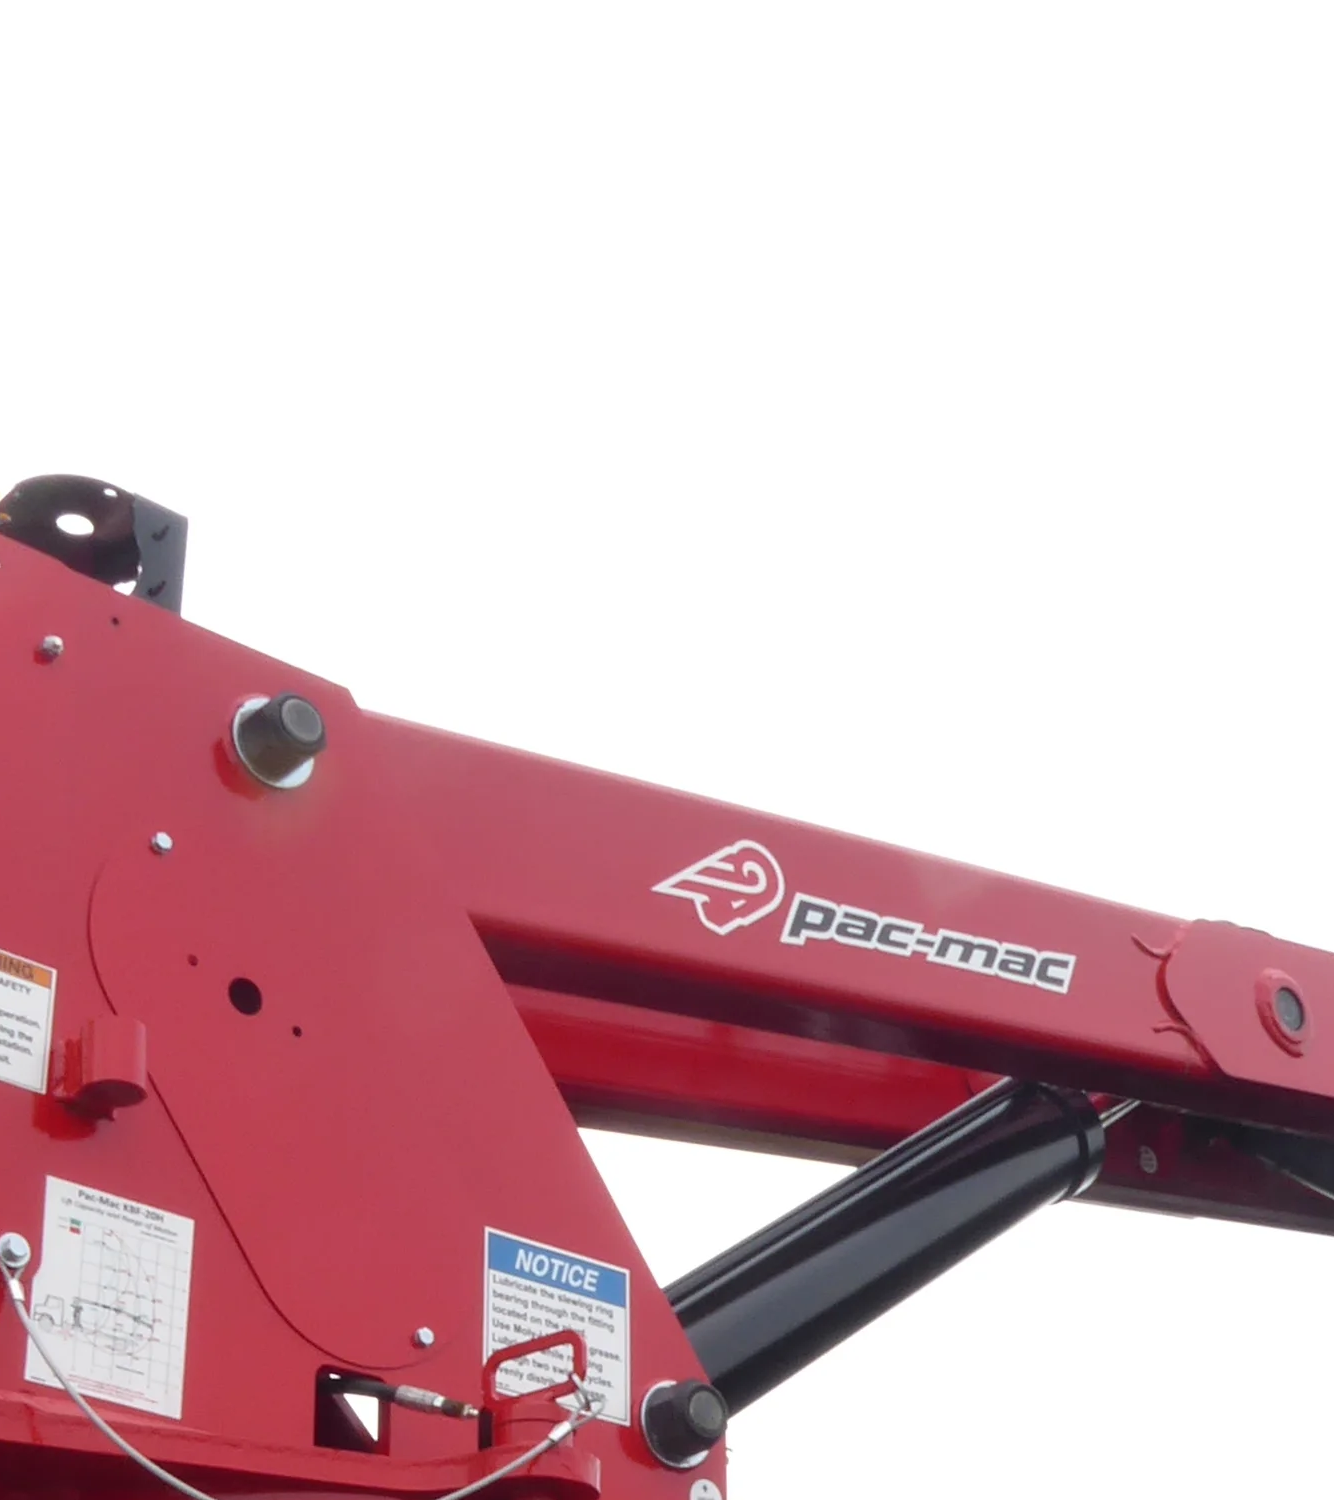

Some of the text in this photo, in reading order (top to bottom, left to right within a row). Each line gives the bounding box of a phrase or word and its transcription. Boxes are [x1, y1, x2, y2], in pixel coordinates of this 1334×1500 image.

[784, 895, 1072, 990] pac-mac
[17, 1030, 33, 1043] the
[515, 1248, 599, 1292] NOTICE
[492, 1274, 613, 1319] Lubricate the slewing ring
[492, 1289, 528, 1308] bearing
[531, 1299, 568, 1320] through
[570, 1311, 585, 1323] the
[588, 1315, 614, 1333] fitting
[492, 1303, 559, 1330] located on the
[492, 1318, 510, 1331] Use
[589, 1346, 621, 1363] grease.
